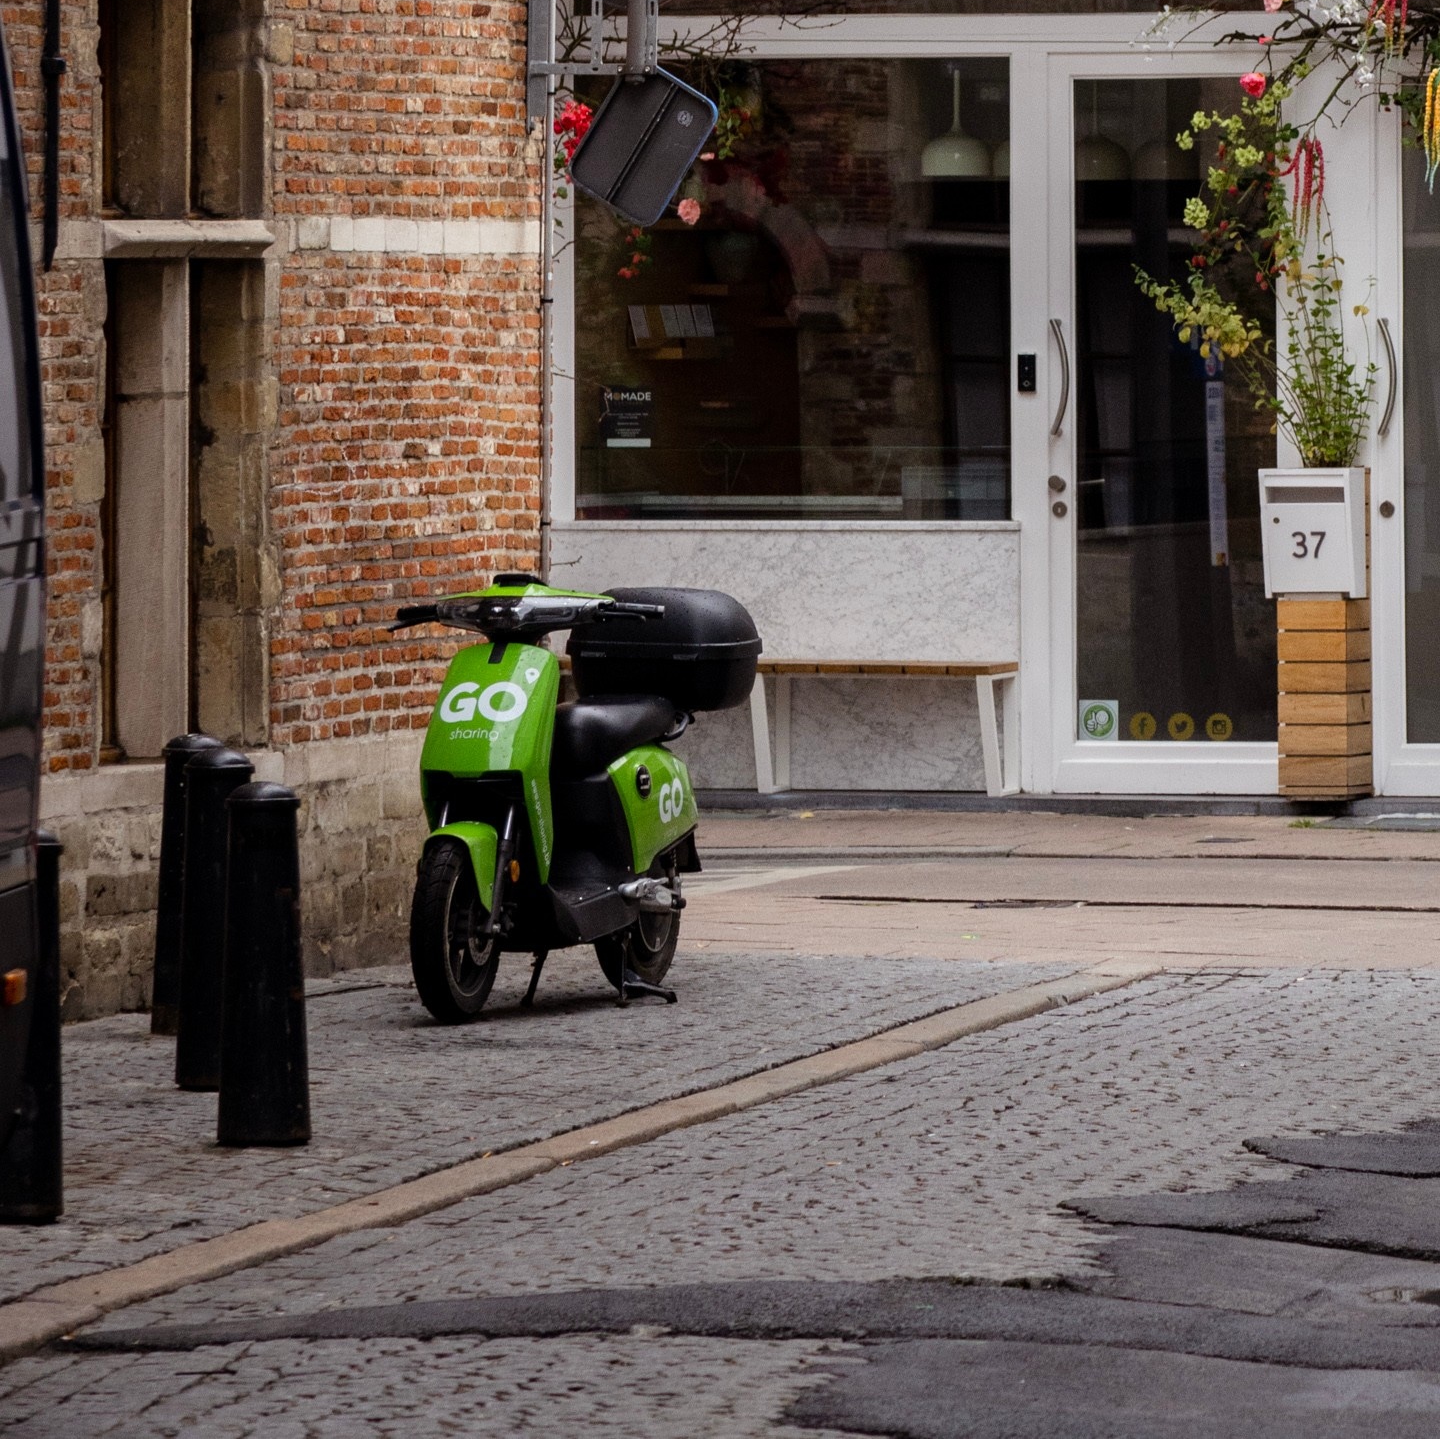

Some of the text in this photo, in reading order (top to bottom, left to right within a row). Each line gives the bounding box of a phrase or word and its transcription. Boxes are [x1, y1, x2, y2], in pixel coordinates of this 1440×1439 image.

[1291, 531, 1326, 559] 37
[440, 682, 527, 723] GO
[450, 728, 499, 741] sharing
[659, 777, 684, 824] GO
